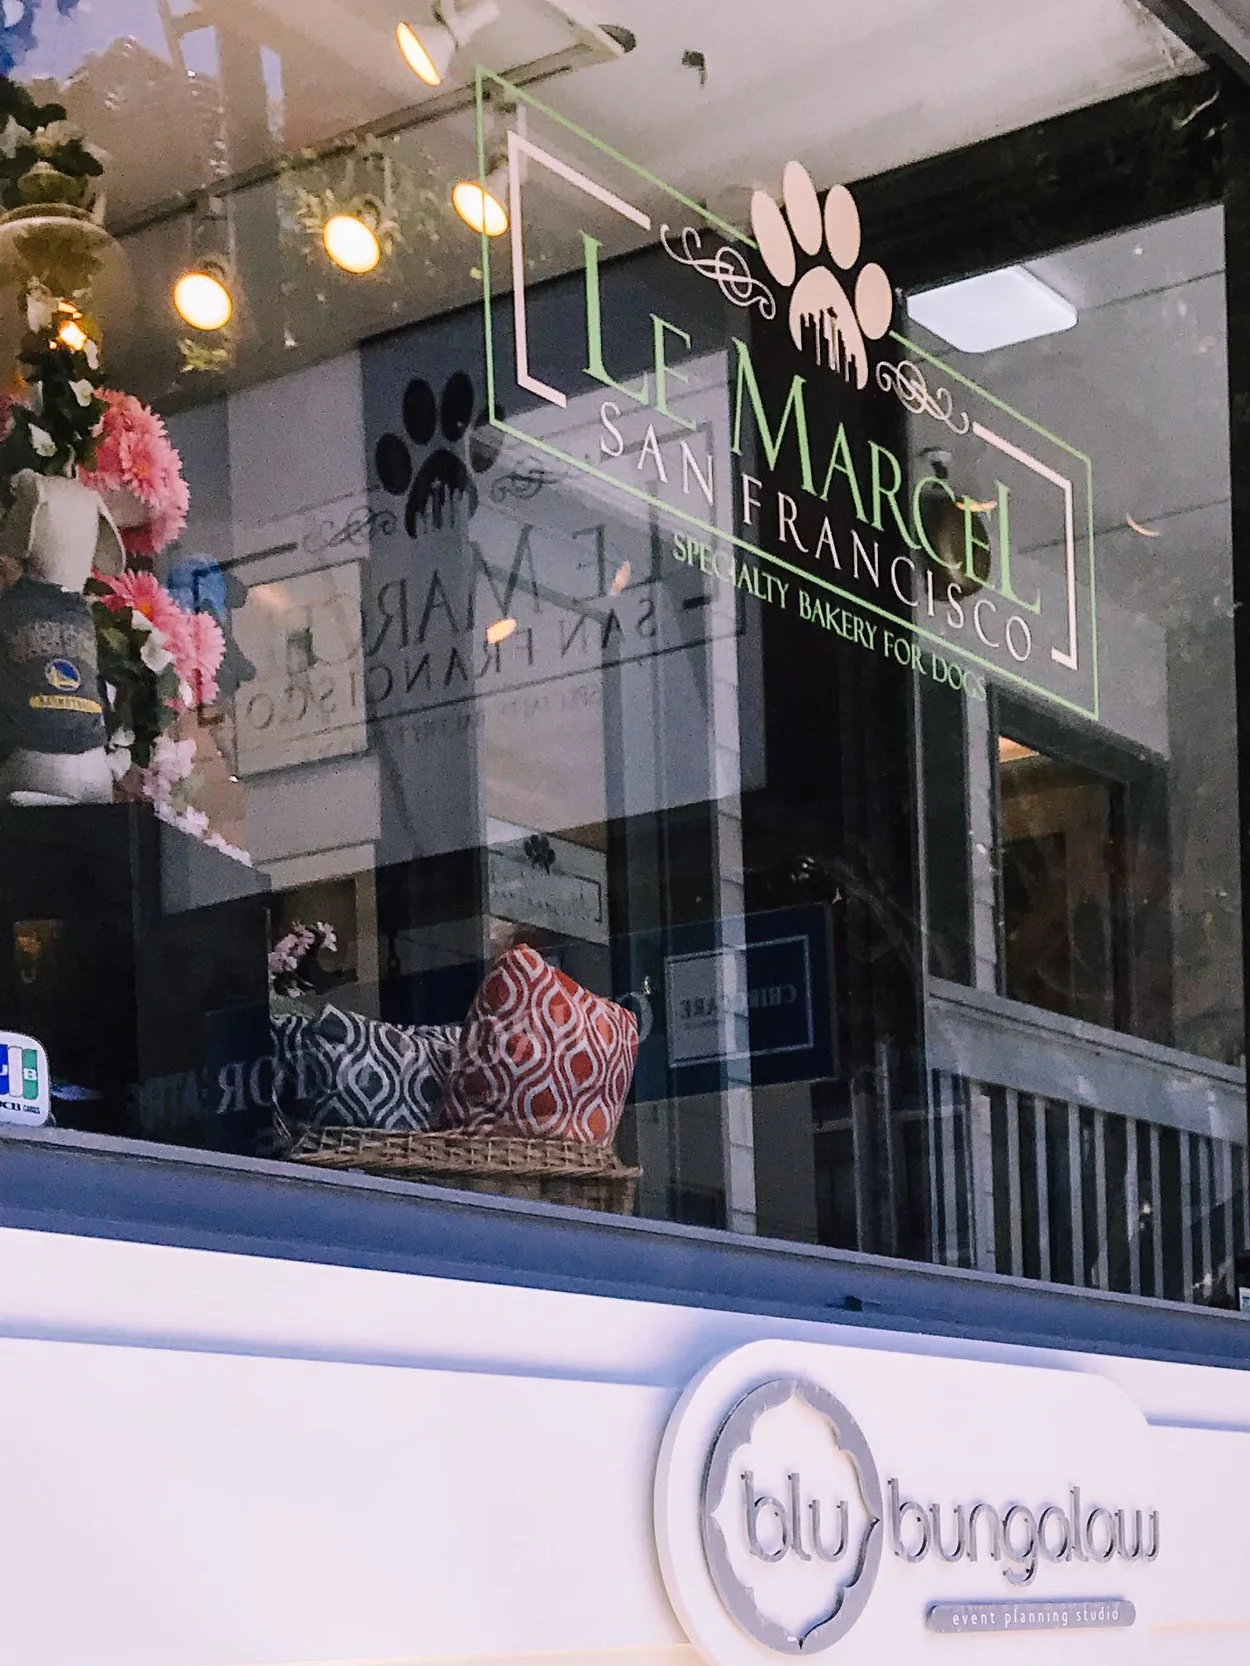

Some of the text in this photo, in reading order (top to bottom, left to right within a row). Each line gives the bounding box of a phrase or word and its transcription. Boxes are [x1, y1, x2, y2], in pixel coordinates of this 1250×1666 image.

[579, 229, 1041, 615] LE MARCEL
[600, 401, 1032, 662] SAN FRANCISCO
[672, 531, 988, 702] SPECIALTY BAKERY FOR DOGS
[741, 1470, 1160, 1587] blu bungalow
[952, 1606, 1120, 1628] event planning studio
